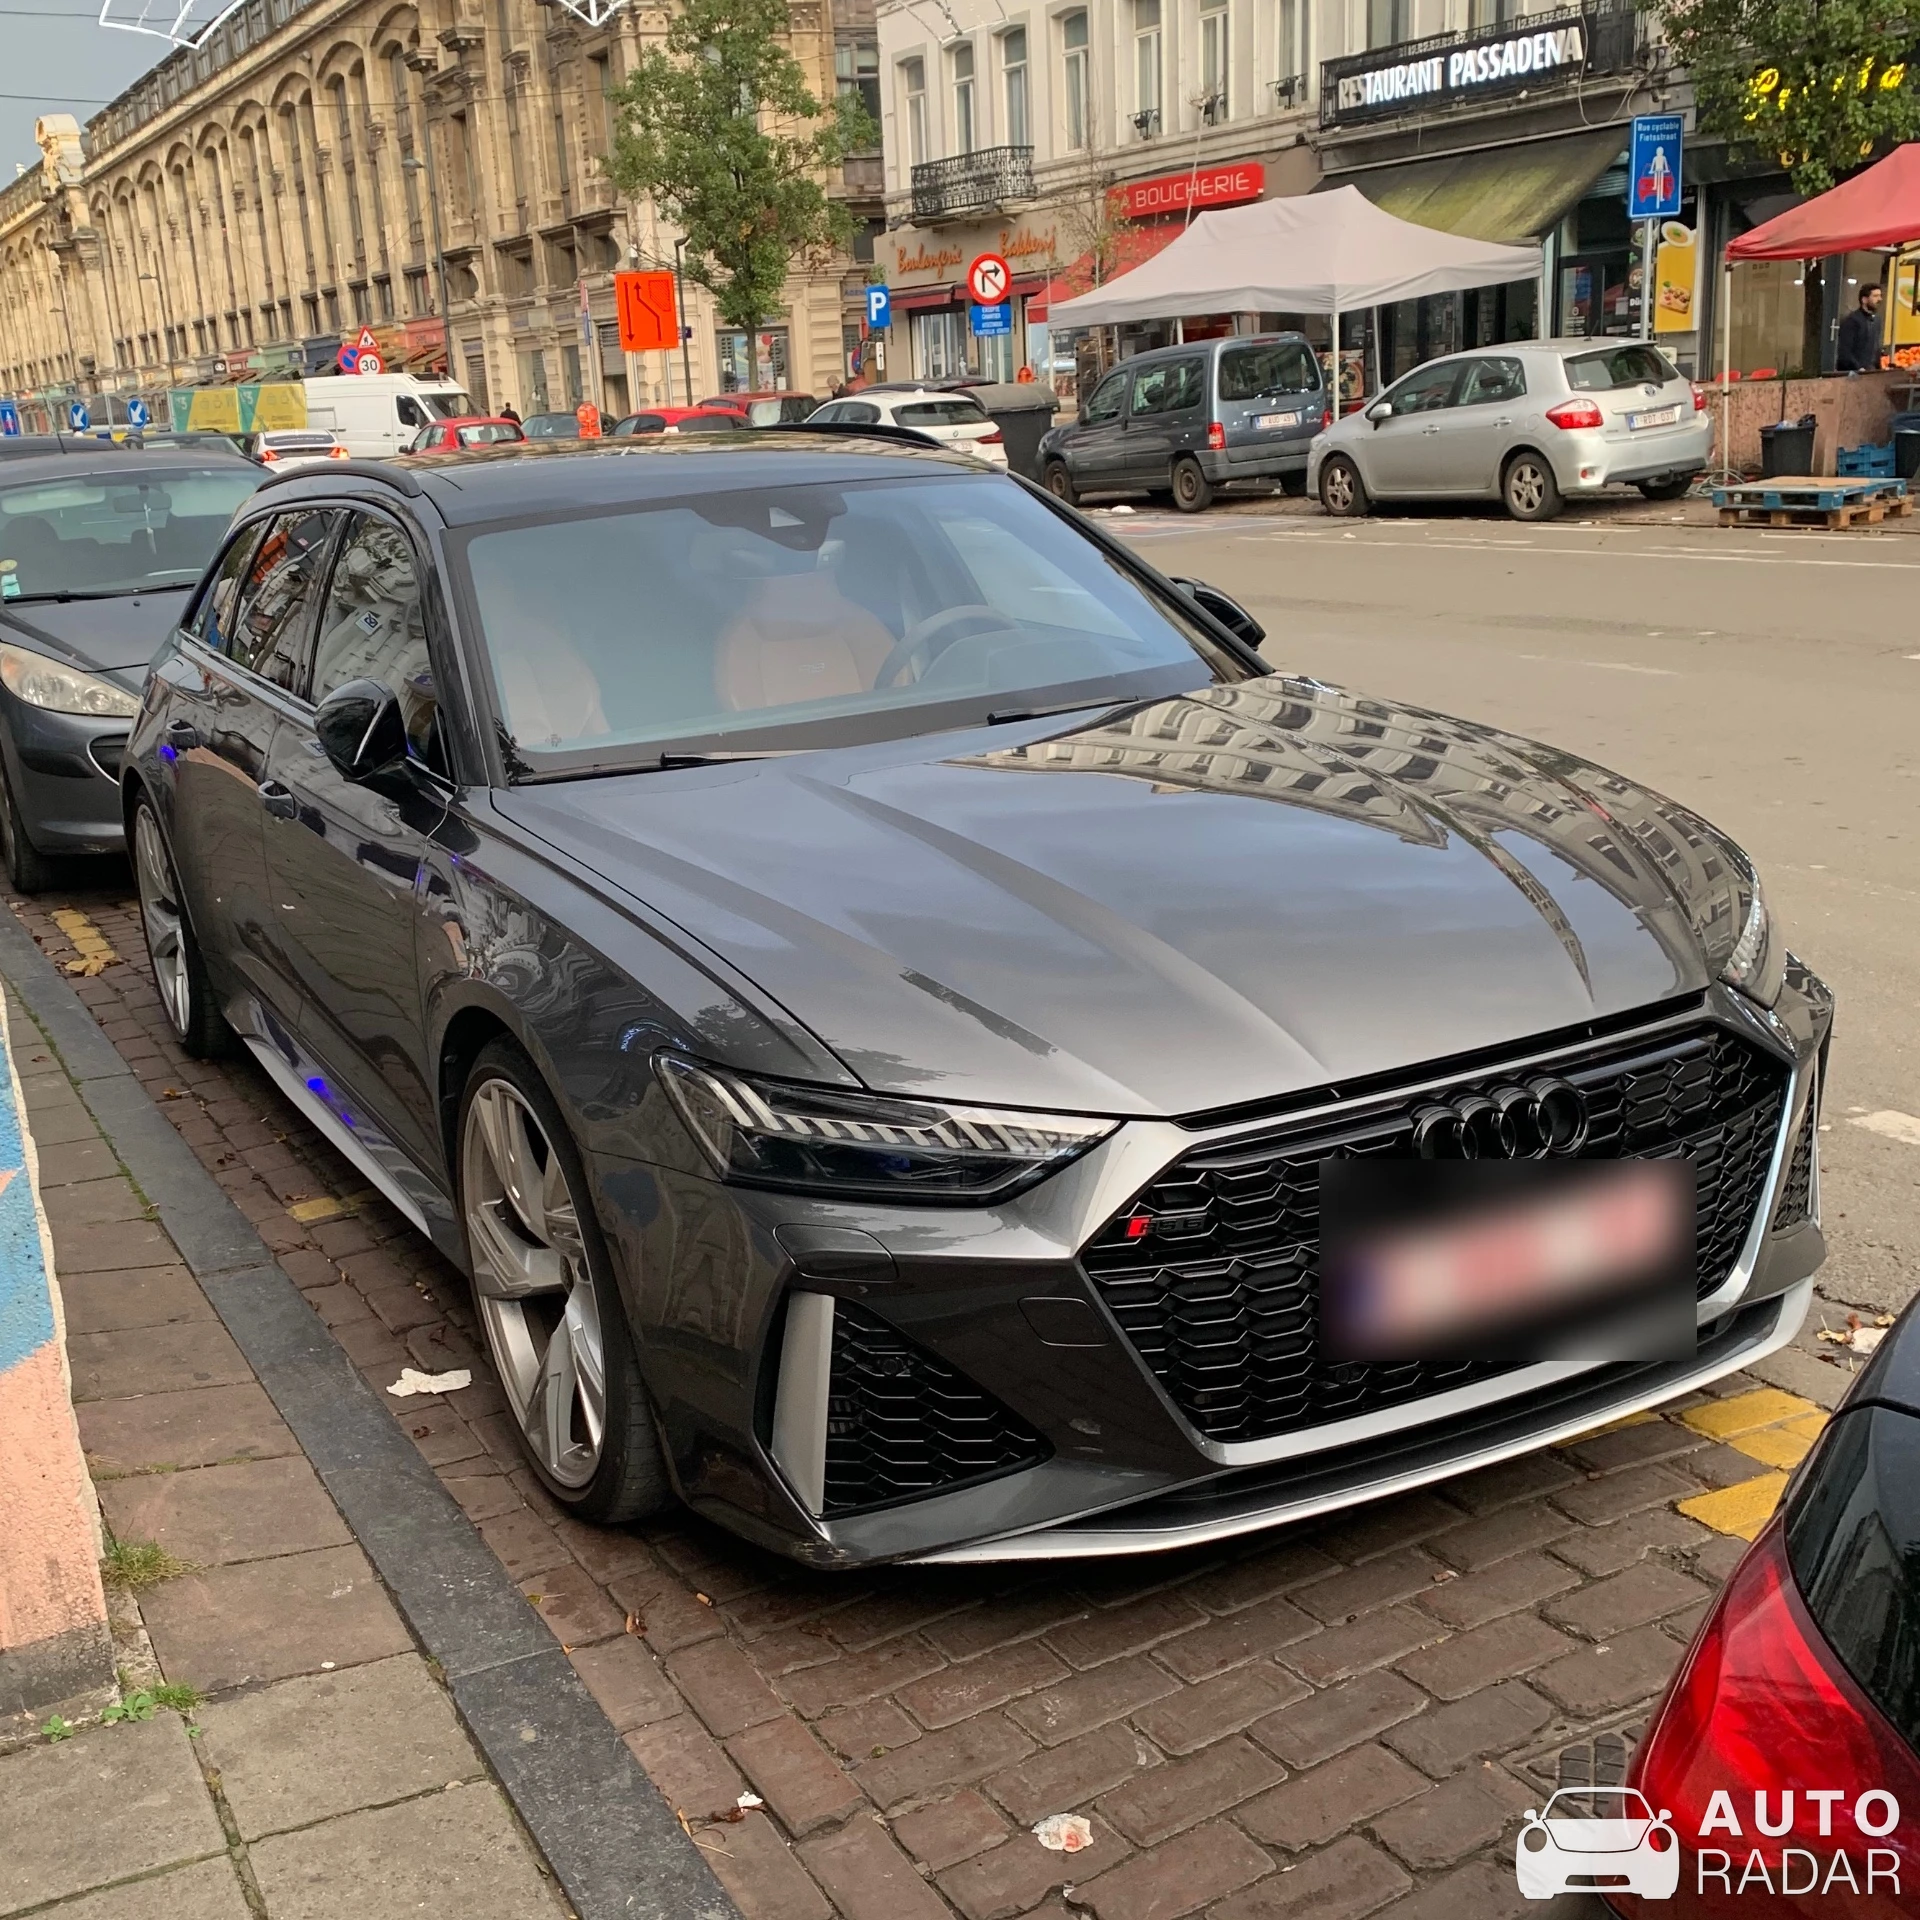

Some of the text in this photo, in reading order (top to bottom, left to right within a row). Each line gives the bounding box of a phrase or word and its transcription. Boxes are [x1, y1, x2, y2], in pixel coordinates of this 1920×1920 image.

[1338, 26, 1583, 110] RESTAURANT PASSADENA
[1637, 121, 1680, 133] Rue cyclable
[1639, 132, 1677, 142] Fietsstraat
[1135, 172, 1250, 208] BOUCHERIE
[897, 225, 1056, 279] Boulangerie Bakkerij
[870, 292, 887, 321] P
[361, 359, 379, 371] 30
